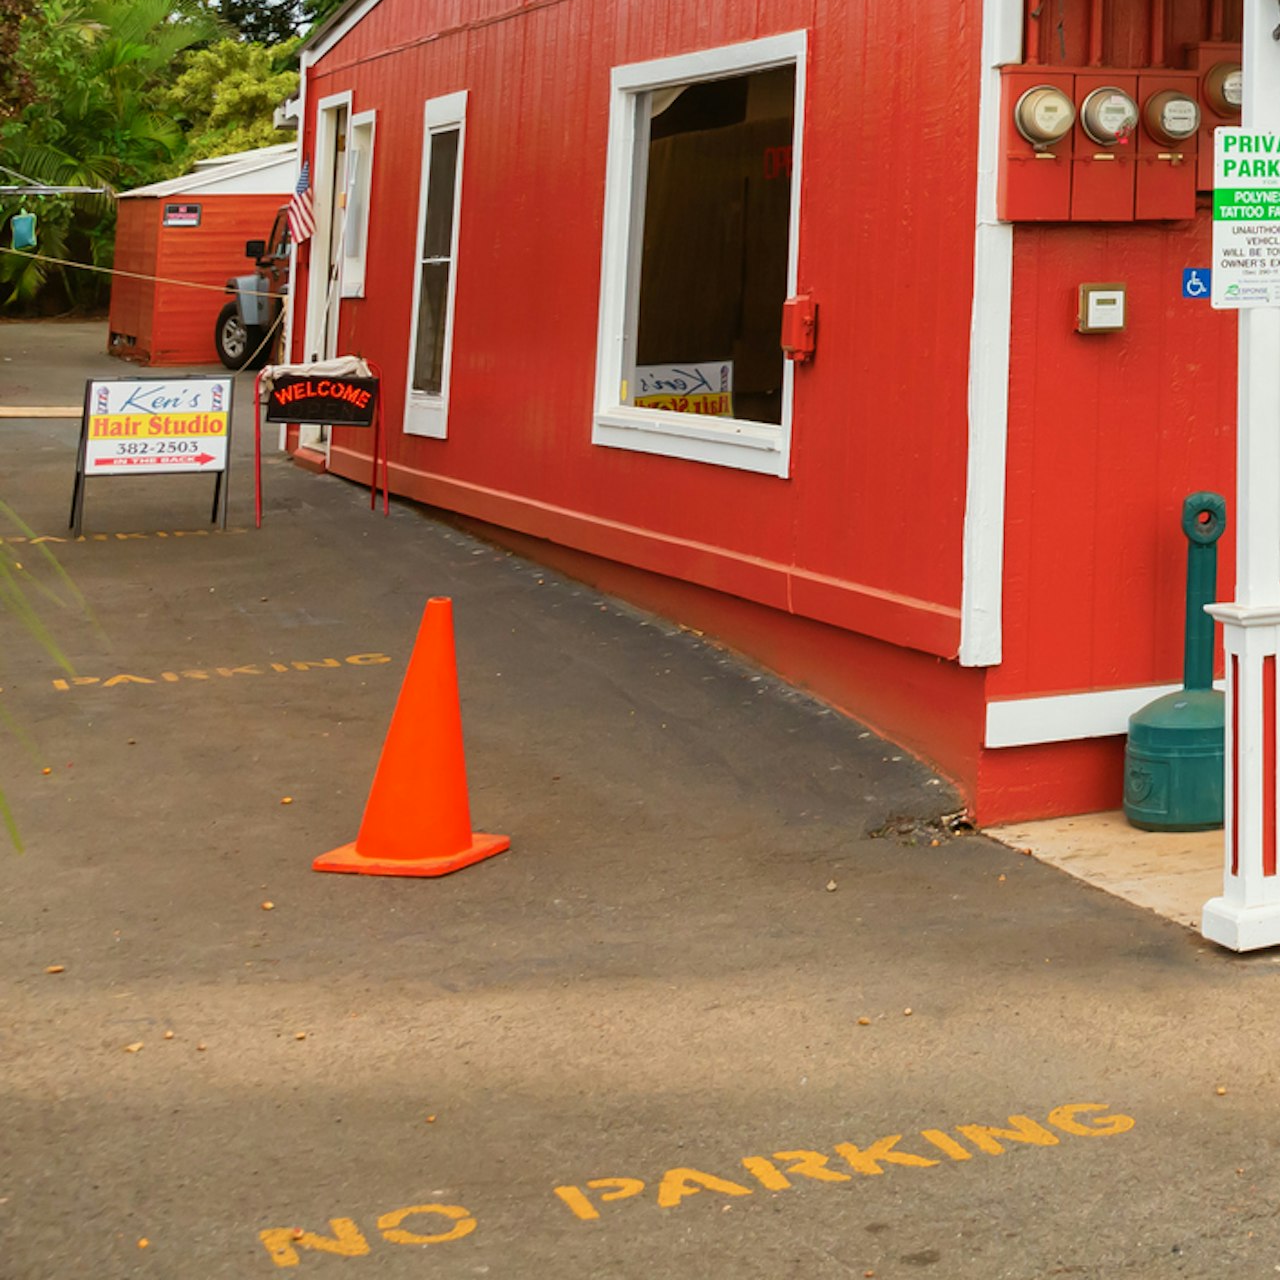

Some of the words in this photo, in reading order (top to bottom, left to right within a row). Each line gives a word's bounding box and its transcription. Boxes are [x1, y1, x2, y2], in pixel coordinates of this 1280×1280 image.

[1219, 205, 1264, 218] TATTOO
[1222, 247, 1245, 257] WILL
[1248, 247, 1262, 257] BE
[1220, 259, 1267, 269] OWNER'S
[119, 385, 202, 416] Ken's
[273, 379, 373, 409] WELCOME
[93, 416, 142, 438] Hair
[148, 414, 224, 436] Studio
[116, 440, 199, 455] 382-2503
[113, 457, 128, 465] IN
[132, 456, 157, 464] THE
[160, 455, 196, 463] BACK
[52, 653, 392, 691] PARKING
[257, 1201, 477, 1268] NO
[553, 1102, 1138, 1220] PARKING
